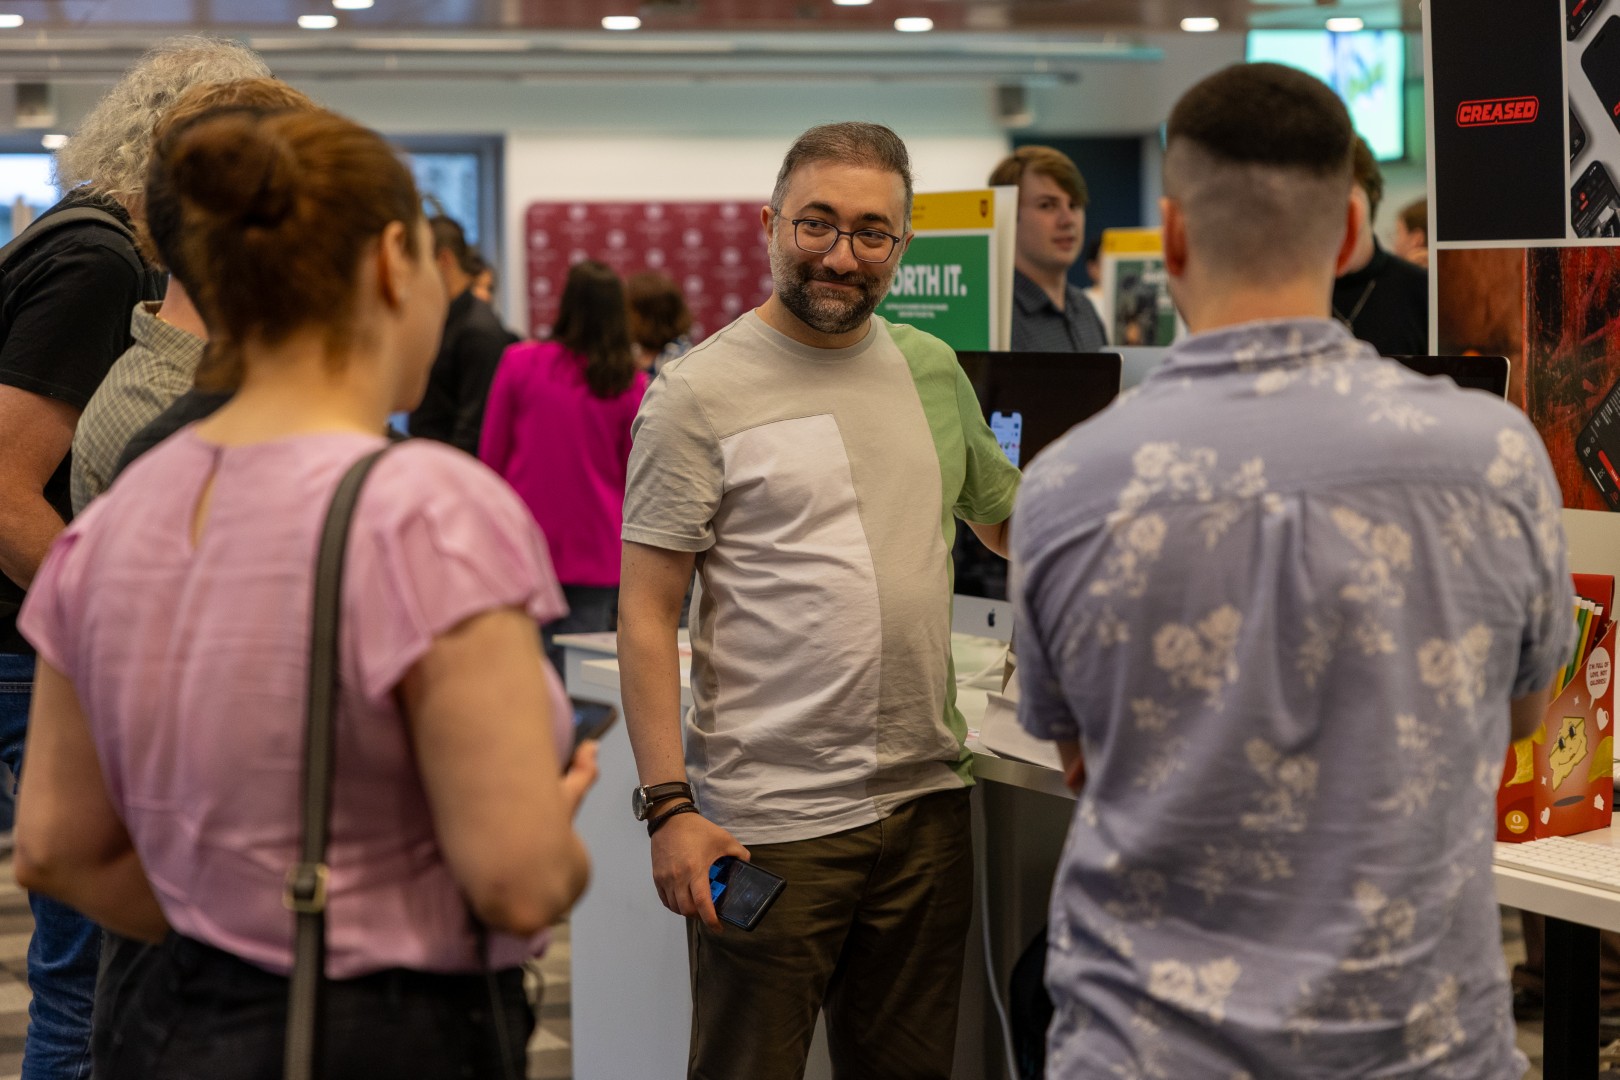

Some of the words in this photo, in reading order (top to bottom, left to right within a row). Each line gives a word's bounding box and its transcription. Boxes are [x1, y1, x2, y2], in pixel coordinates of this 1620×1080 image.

[1460, 101, 1535, 122] CREASED
[891, 264, 940, 296] ORTH
[943, 264, 968, 297] IT.
